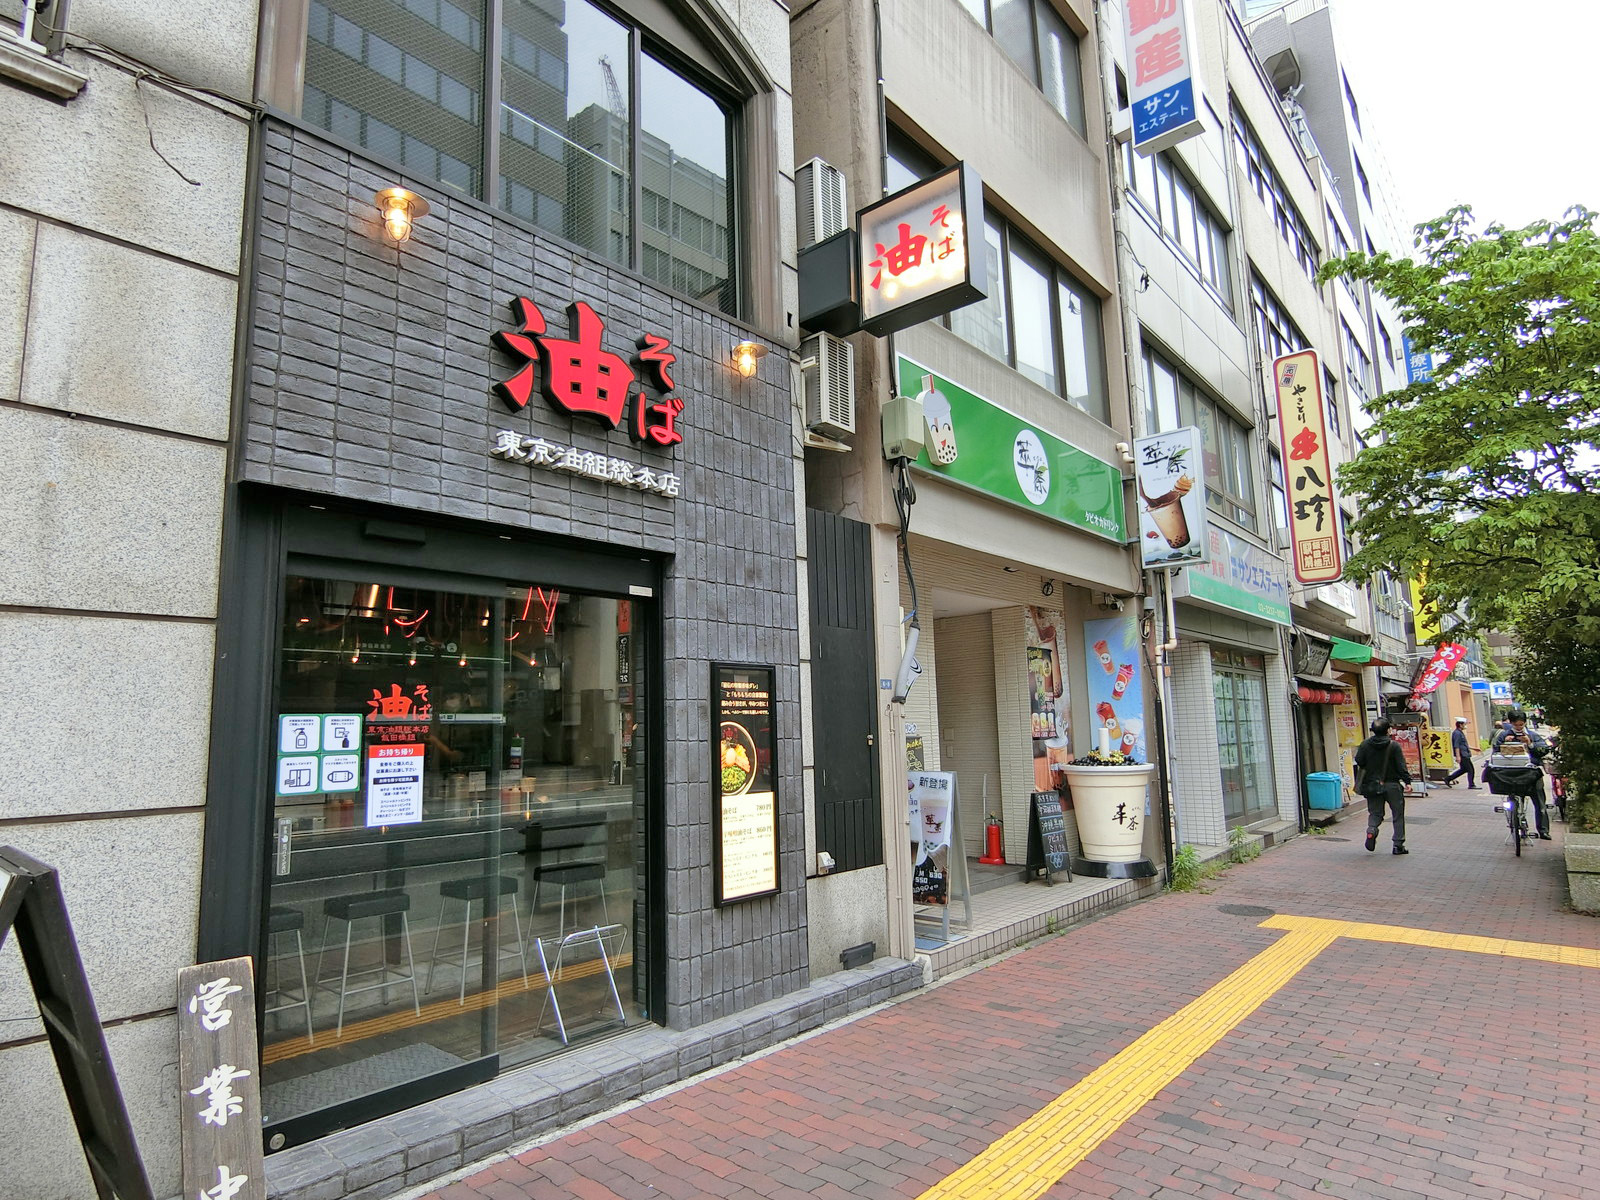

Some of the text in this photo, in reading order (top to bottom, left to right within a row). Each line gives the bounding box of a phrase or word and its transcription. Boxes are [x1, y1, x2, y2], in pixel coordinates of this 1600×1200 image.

[1144, 89, 1180, 115] サン
[1139, 104, 1189, 134] エステート
[868, 204, 956, 290] 油そば
[491, 296, 685, 445] 油そば
[490, 430, 681, 498] 東京油組総本店
[1085, 510, 1120, 534] タピオカドリンク
[1238, 557, 1284, 597] サンエステート
[1423, 646, 1461, 690] お弁当
[367, 683, 432, 721] 油そば
[367, 725, 430, 734] 東京油組総本店
[378, 748, 414, 757] お持ち帰り
[1426, 733, 1443, 764] 庄や
[919, 777, 948, 790] 新登場
